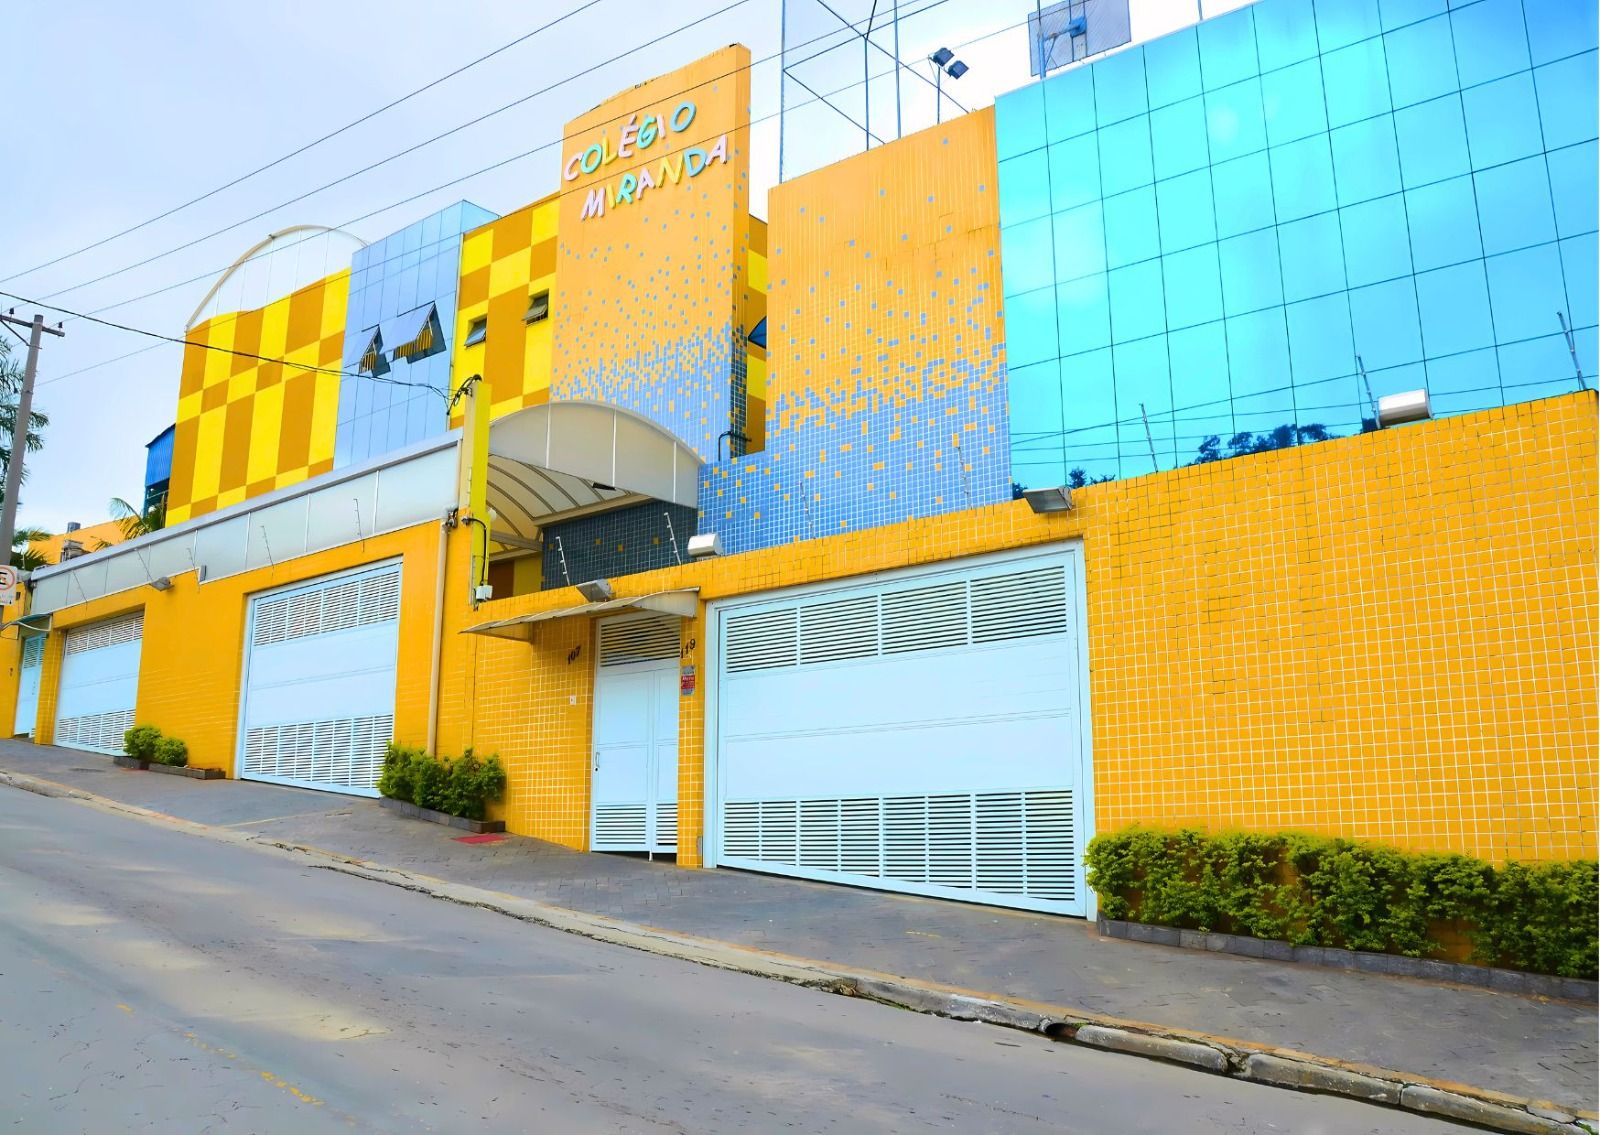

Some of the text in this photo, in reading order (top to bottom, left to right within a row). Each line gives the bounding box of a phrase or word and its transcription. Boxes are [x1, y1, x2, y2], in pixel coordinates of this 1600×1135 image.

[563, 101, 698, 182] COLÉGIO
[581, 134, 729, 221] MIRANDA
[567, 644, 581, 665] 107
[680, 638, 696, 659] 119
